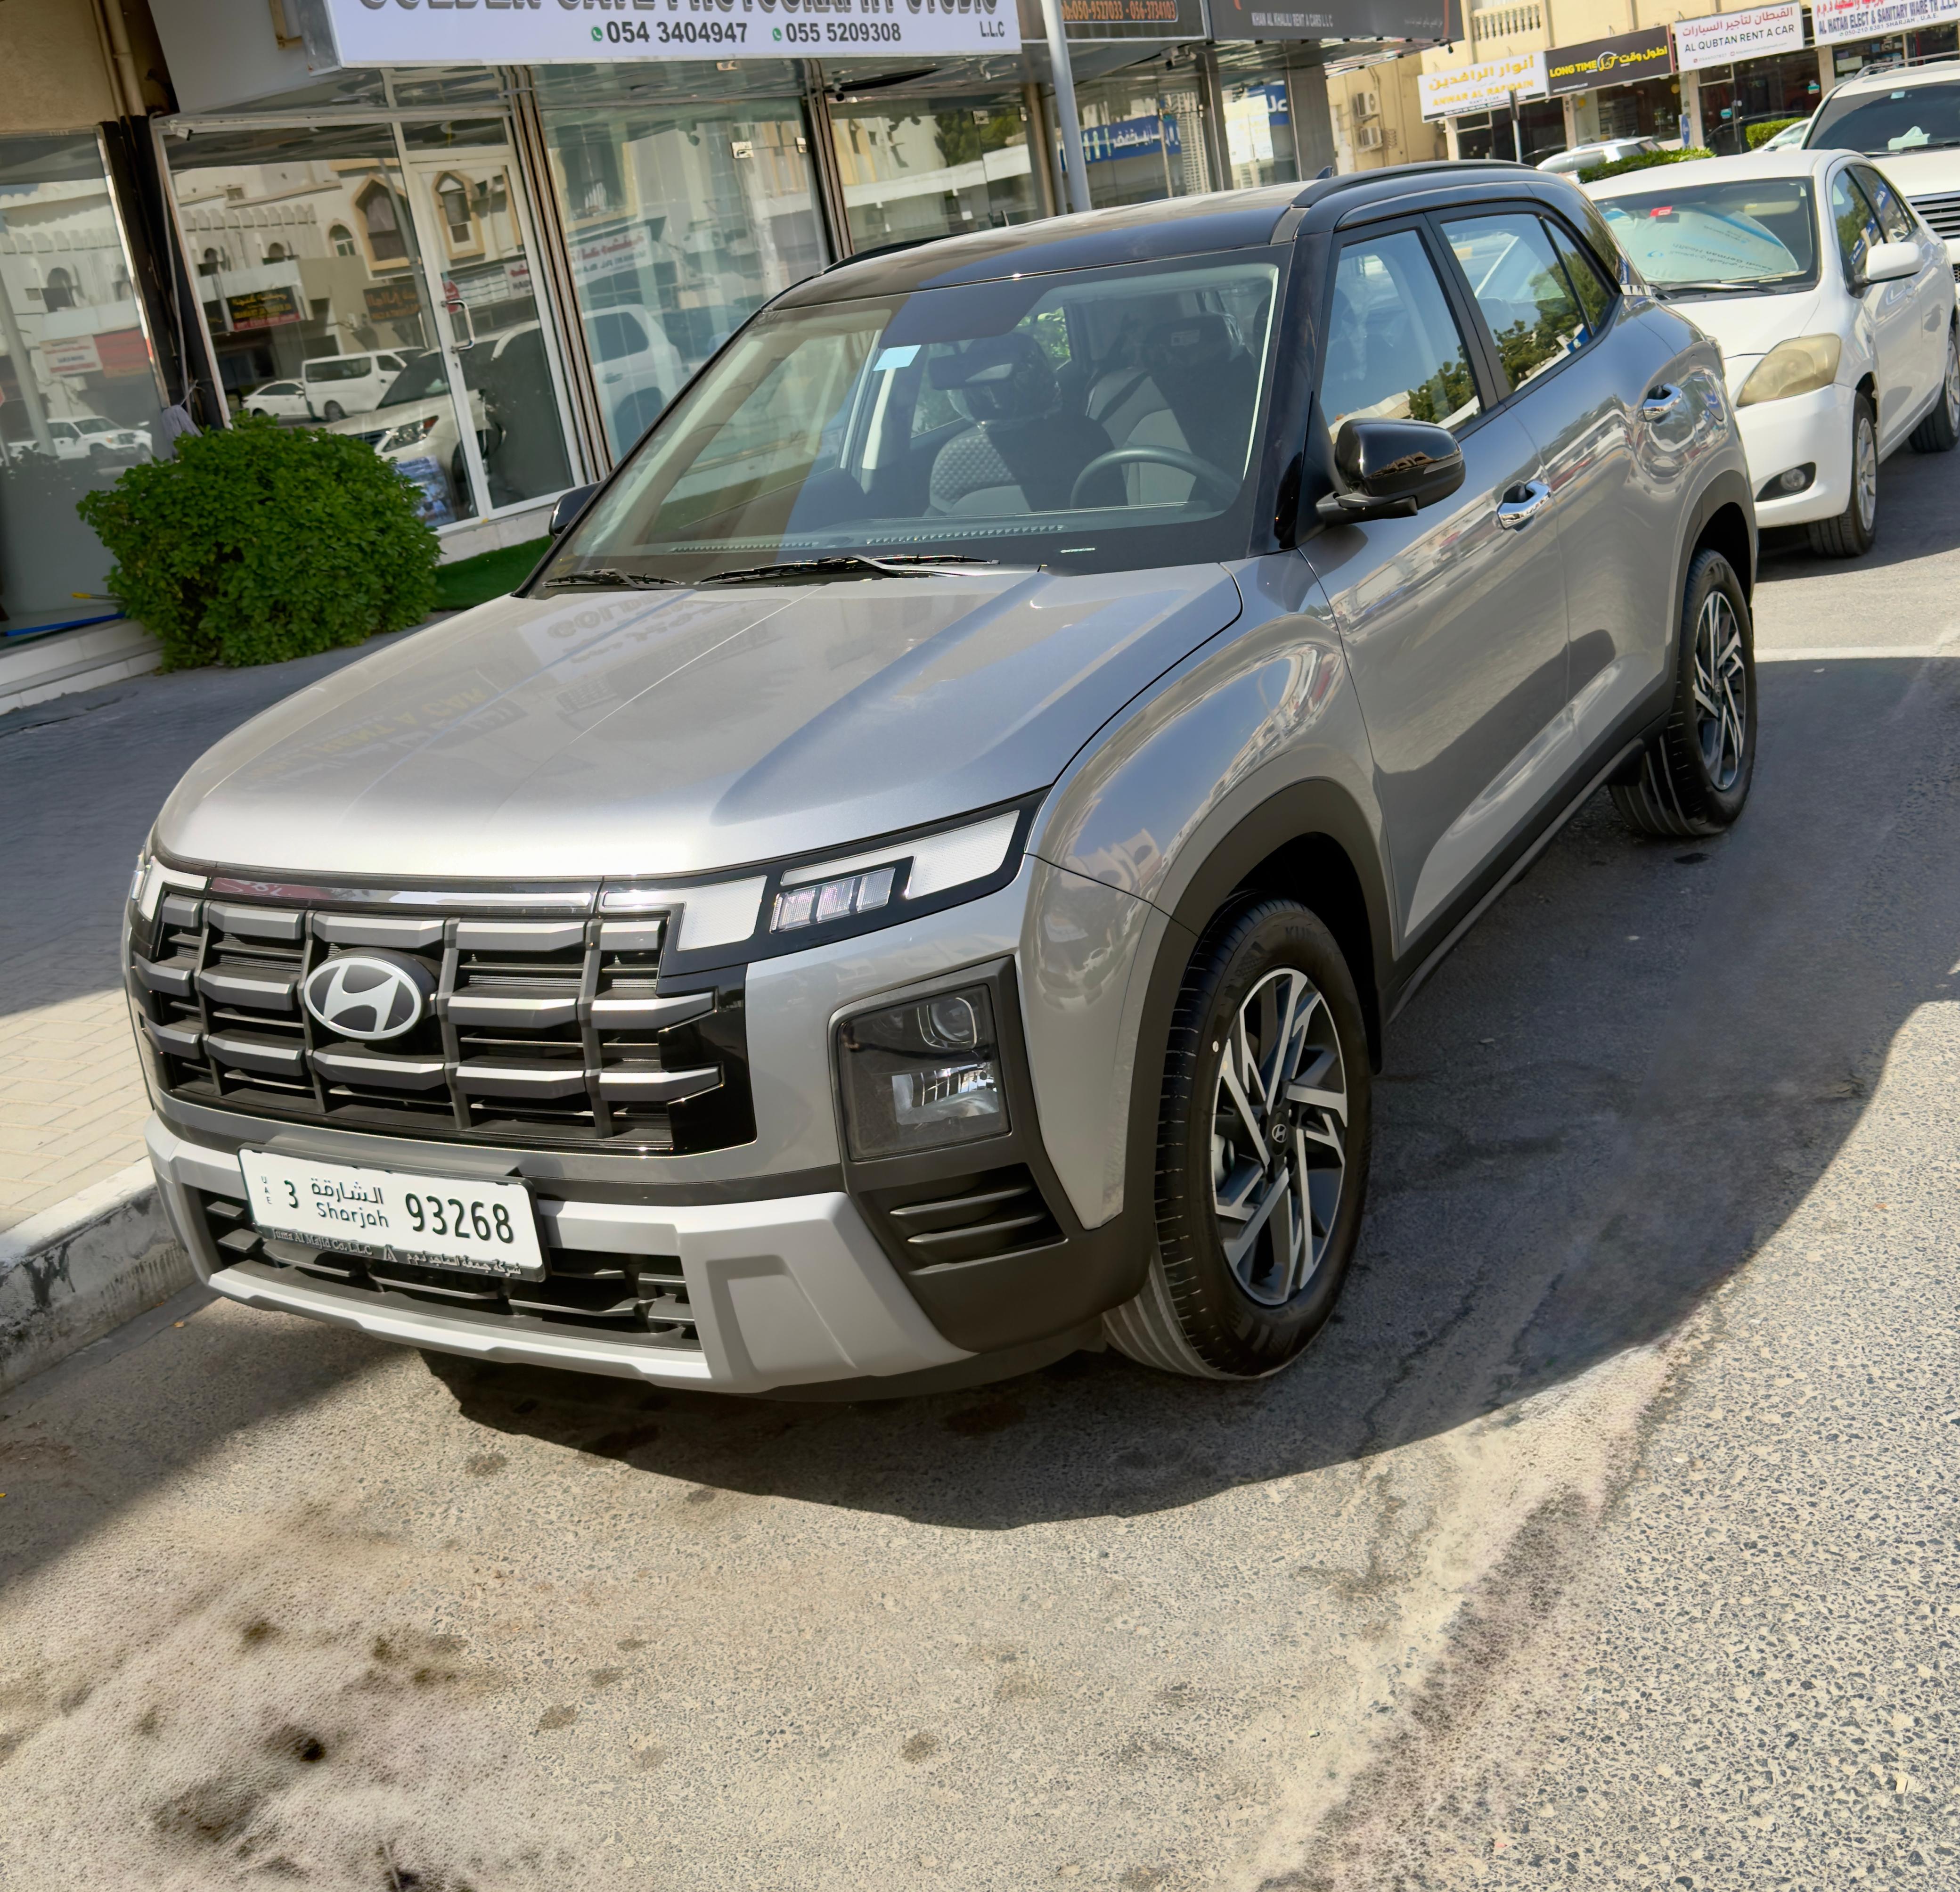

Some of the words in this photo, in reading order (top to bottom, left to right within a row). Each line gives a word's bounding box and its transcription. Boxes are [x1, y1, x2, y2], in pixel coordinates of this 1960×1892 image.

[1726, 16, 1751, 31] لتأجير
[1755, 7, 1793, 25] القبطان
[1850, 11, 1869, 29] ELECT
[1878, 3, 1907, 23] SANITARY
[1886, 18, 1915, 28] SHARJAH
[607, 21, 650, 43] 054
[657, 22, 747, 43] 3404947
[786, 23, 820, 42] 055
[827, 23, 901, 42] 5209308
[1682, 20, 1723, 37] السيارات
[1684, 44, 1696, 52] AL
[1698, 36, 1738, 50] QUBTAN
[1740, 30, 1764, 42] RENT
[1766, 28, 1773, 37] A
[1775, 24, 1795, 35] CAR
[1498, 55, 1534, 77] أنوار
[1549, 65, 1575, 78] LONG
[1575, 60, 1597, 72] TIME
[1433, 92, 1469, 106] ANWAR
[1471, 89, 1484, 98] AL
[284, 1179, 299, 1209] 3
[311, 1177, 384, 1204] الشارقة
[316, 1202, 389, 1229] Sharjah
[404, 1192, 514, 1244] 93268
[272, 1228, 293, 1241] Juma
[295, 1232, 305, 1243] Al
[306, 1235, 331, 1249] Majid
[429, 1253, 460, 1266] الماجد
[462, 1254, 491, 1273] جمعة
[493, 1259, 522, 1277] شركة
